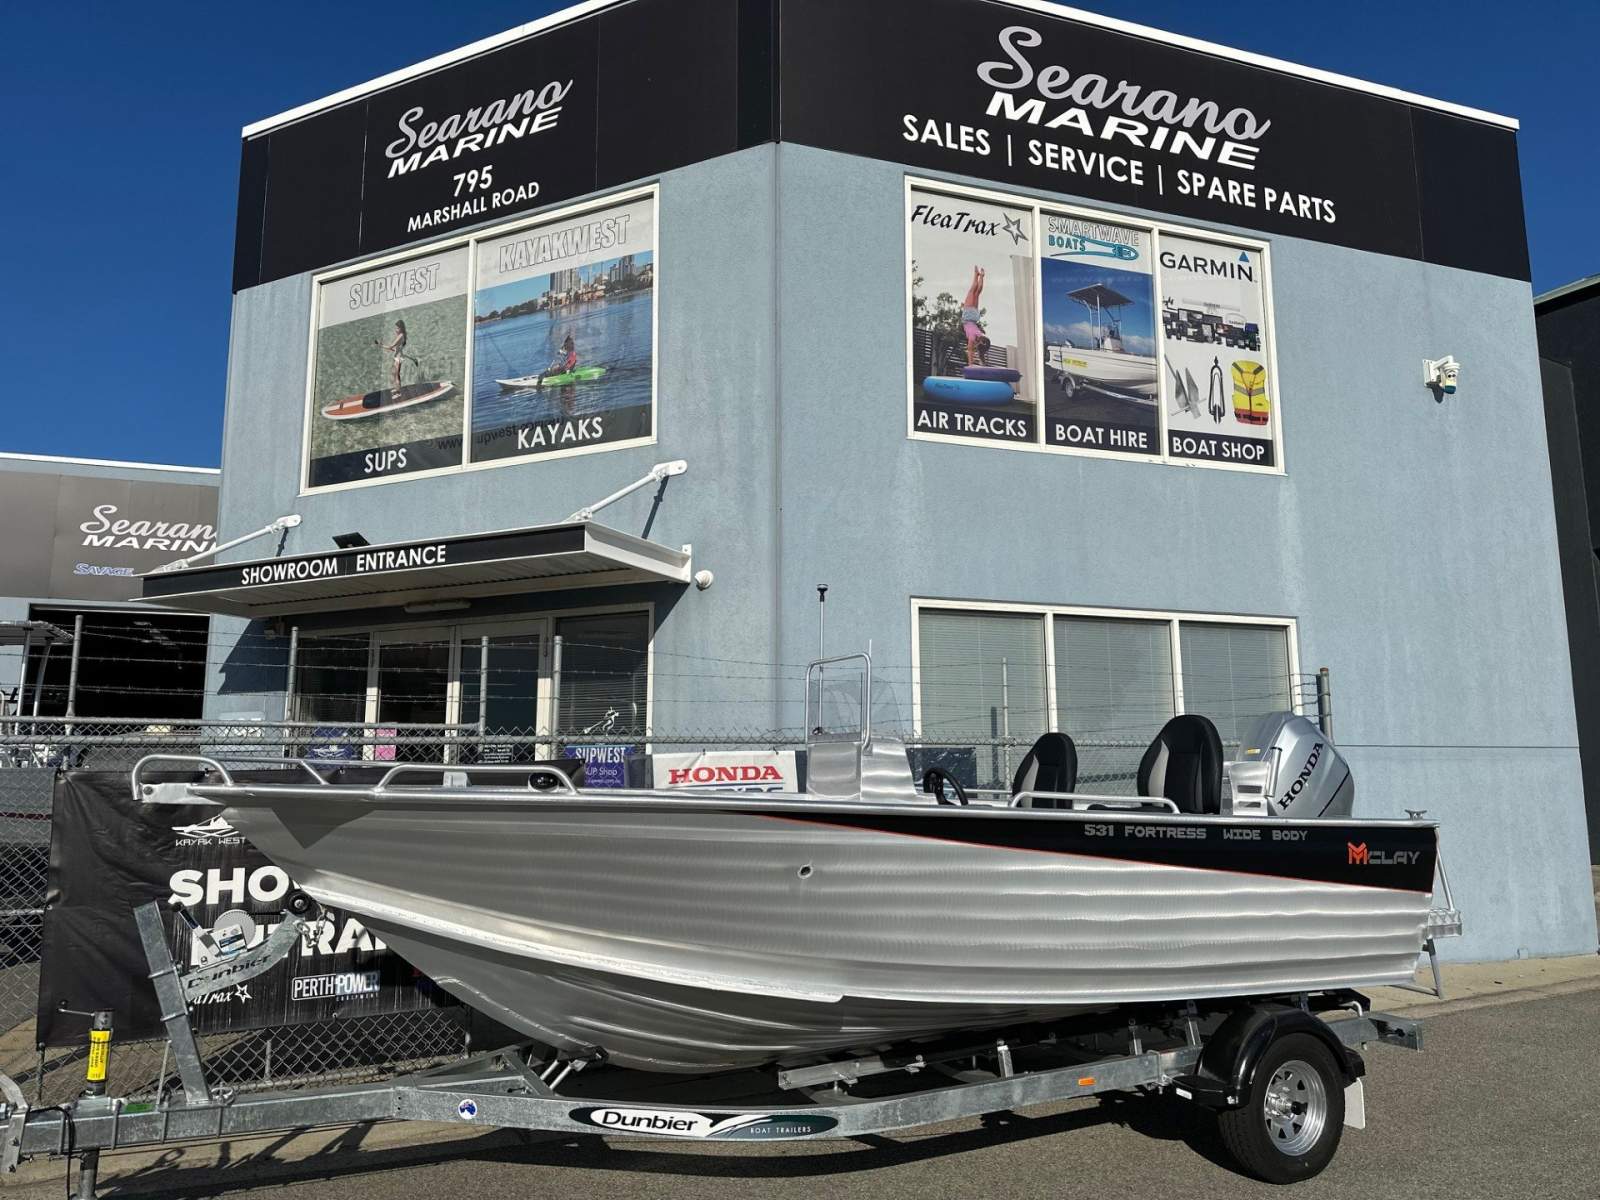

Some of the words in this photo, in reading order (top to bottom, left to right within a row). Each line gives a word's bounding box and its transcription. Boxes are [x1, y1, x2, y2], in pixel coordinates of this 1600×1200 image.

[977, 25, 1271, 141] Searano
[385, 79, 573, 159] Searano
[985, 91, 1260, 170] MARINE
[387, 106, 563, 178] MARINE
[453, 165, 494, 198] 795
[903, 114, 991, 156] SALES
[1028, 140, 1144, 186] SERVICE
[1177, 169, 1257, 208] SPARE
[1264, 189, 1337, 224] PARTS
[406, 195, 488, 232] MARSHALL
[492, 181, 540, 208] ROAD
[911, 205, 1000, 236] FleaTrax
[499, 214, 632, 273] KAYAKWEST
[1048, 216, 1140, 247] SMARTWAVE
[1048, 234, 1086, 251] BOATS
[1159, 251, 1253, 282] GARMIN
[349, 263, 441, 310] SUPWEST
[517, 417, 603, 449] KAYAKS
[917, 410, 949, 430] AIR
[954, 413, 1027, 438] TRACKS
[1055, 423, 1103, 445] BOAT
[1110, 430, 1148, 449] HIRE
[364, 448, 407, 473] SUPS
[1172, 437, 1217, 456] BOAT
[1221, 442, 1265, 461] SHOP
[80, 504, 216, 541] Searan
[82, 535, 216, 552] MARIN
[241, 557, 338, 585] SHOWROOM
[356, 544, 447, 572] ENTRANCE
[575, 747, 626, 763] SUPWEST
[668, 765, 783, 784] HONDA
[1277, 742, 1323, 810] HONDA
[175, 838, 213, 847] KAYAK
[218, 836, 246, 845] WEST
[1084, 824, 1114, 837] 531
[1124, 826, 1207, 839] FORTRESS
[1223, 829, 1261, 841] WIDE
[1272, 830, 1308, 842] BODY
[168, 865, 301, 907] SHO
[294, 975, 335, 998] PERTH
[336, 972, 380, 995] POWER
[602, 1110, 698, 1131] Dunbier
[750, 1127, 769, 1135] BOAT
[776, 1126, 811, 1135] TRAILERS
